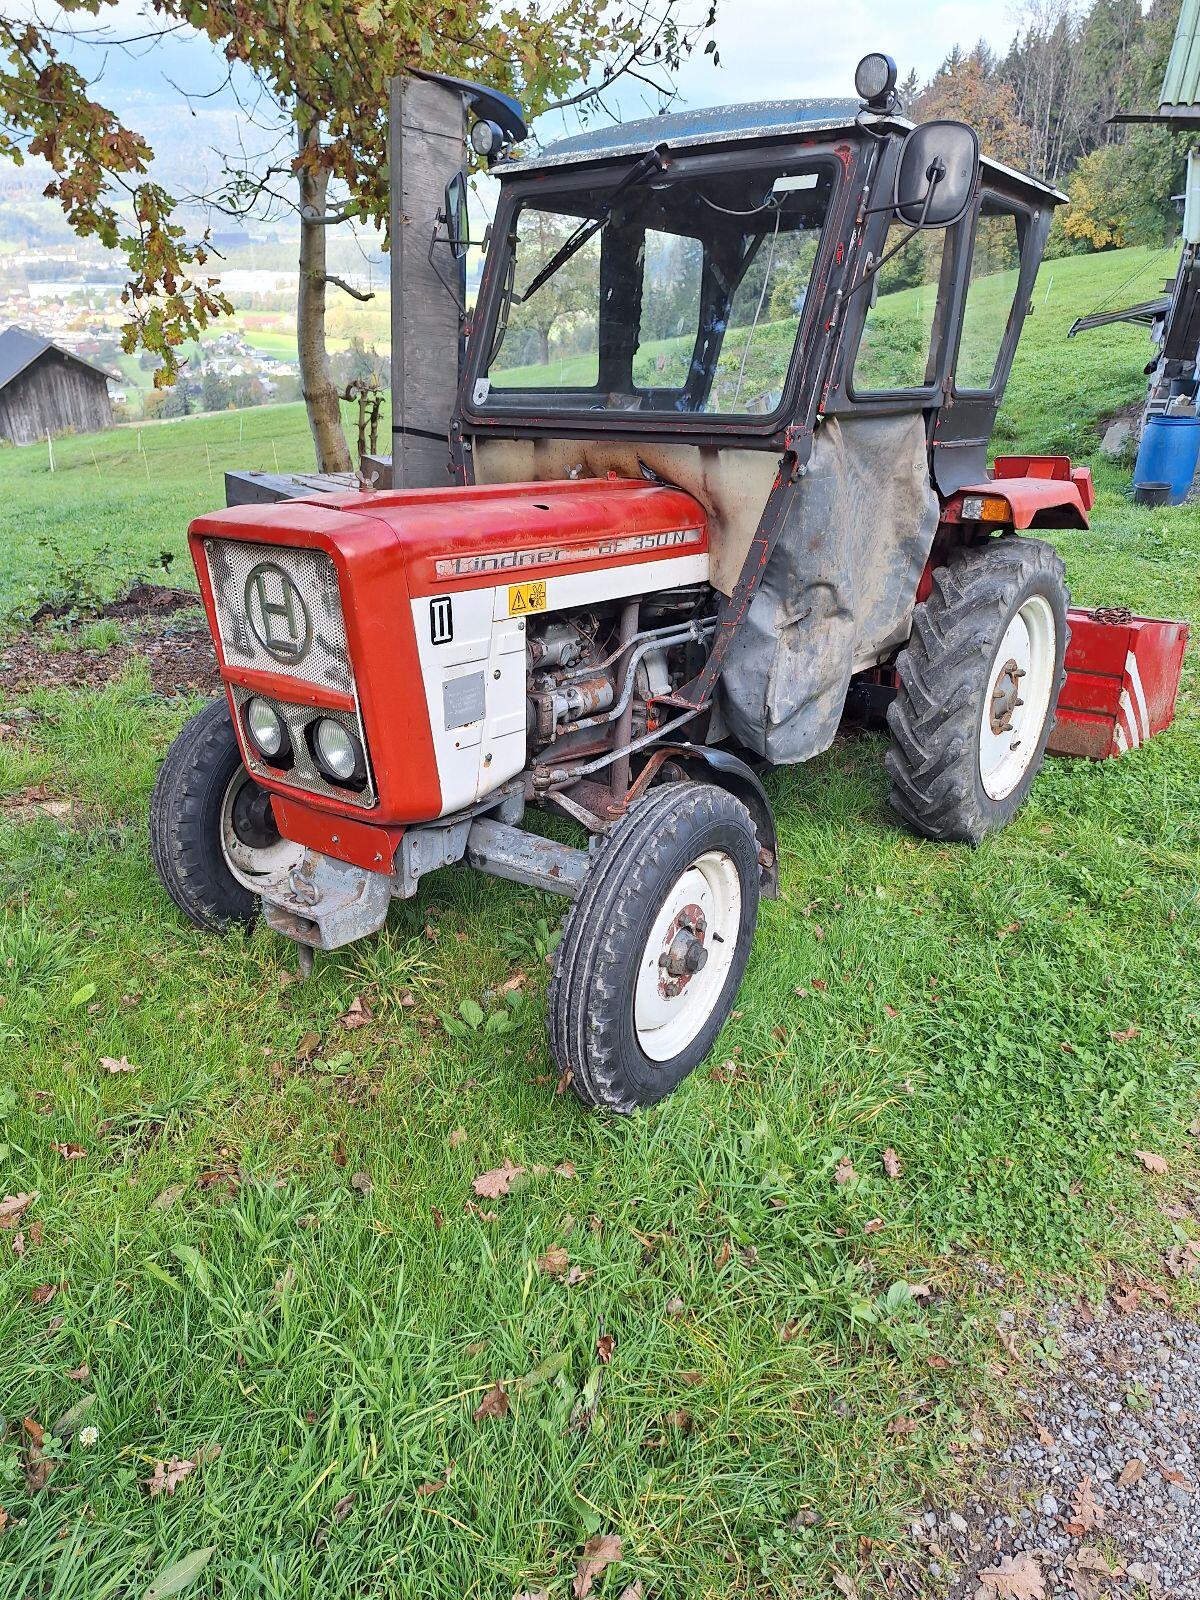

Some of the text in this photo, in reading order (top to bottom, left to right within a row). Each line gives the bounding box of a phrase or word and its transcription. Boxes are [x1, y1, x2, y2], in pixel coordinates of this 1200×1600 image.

[455, 549, 569, 575] Lindner
[630, 532, 669, 549] 350
[673, 530, 685, 544] N
